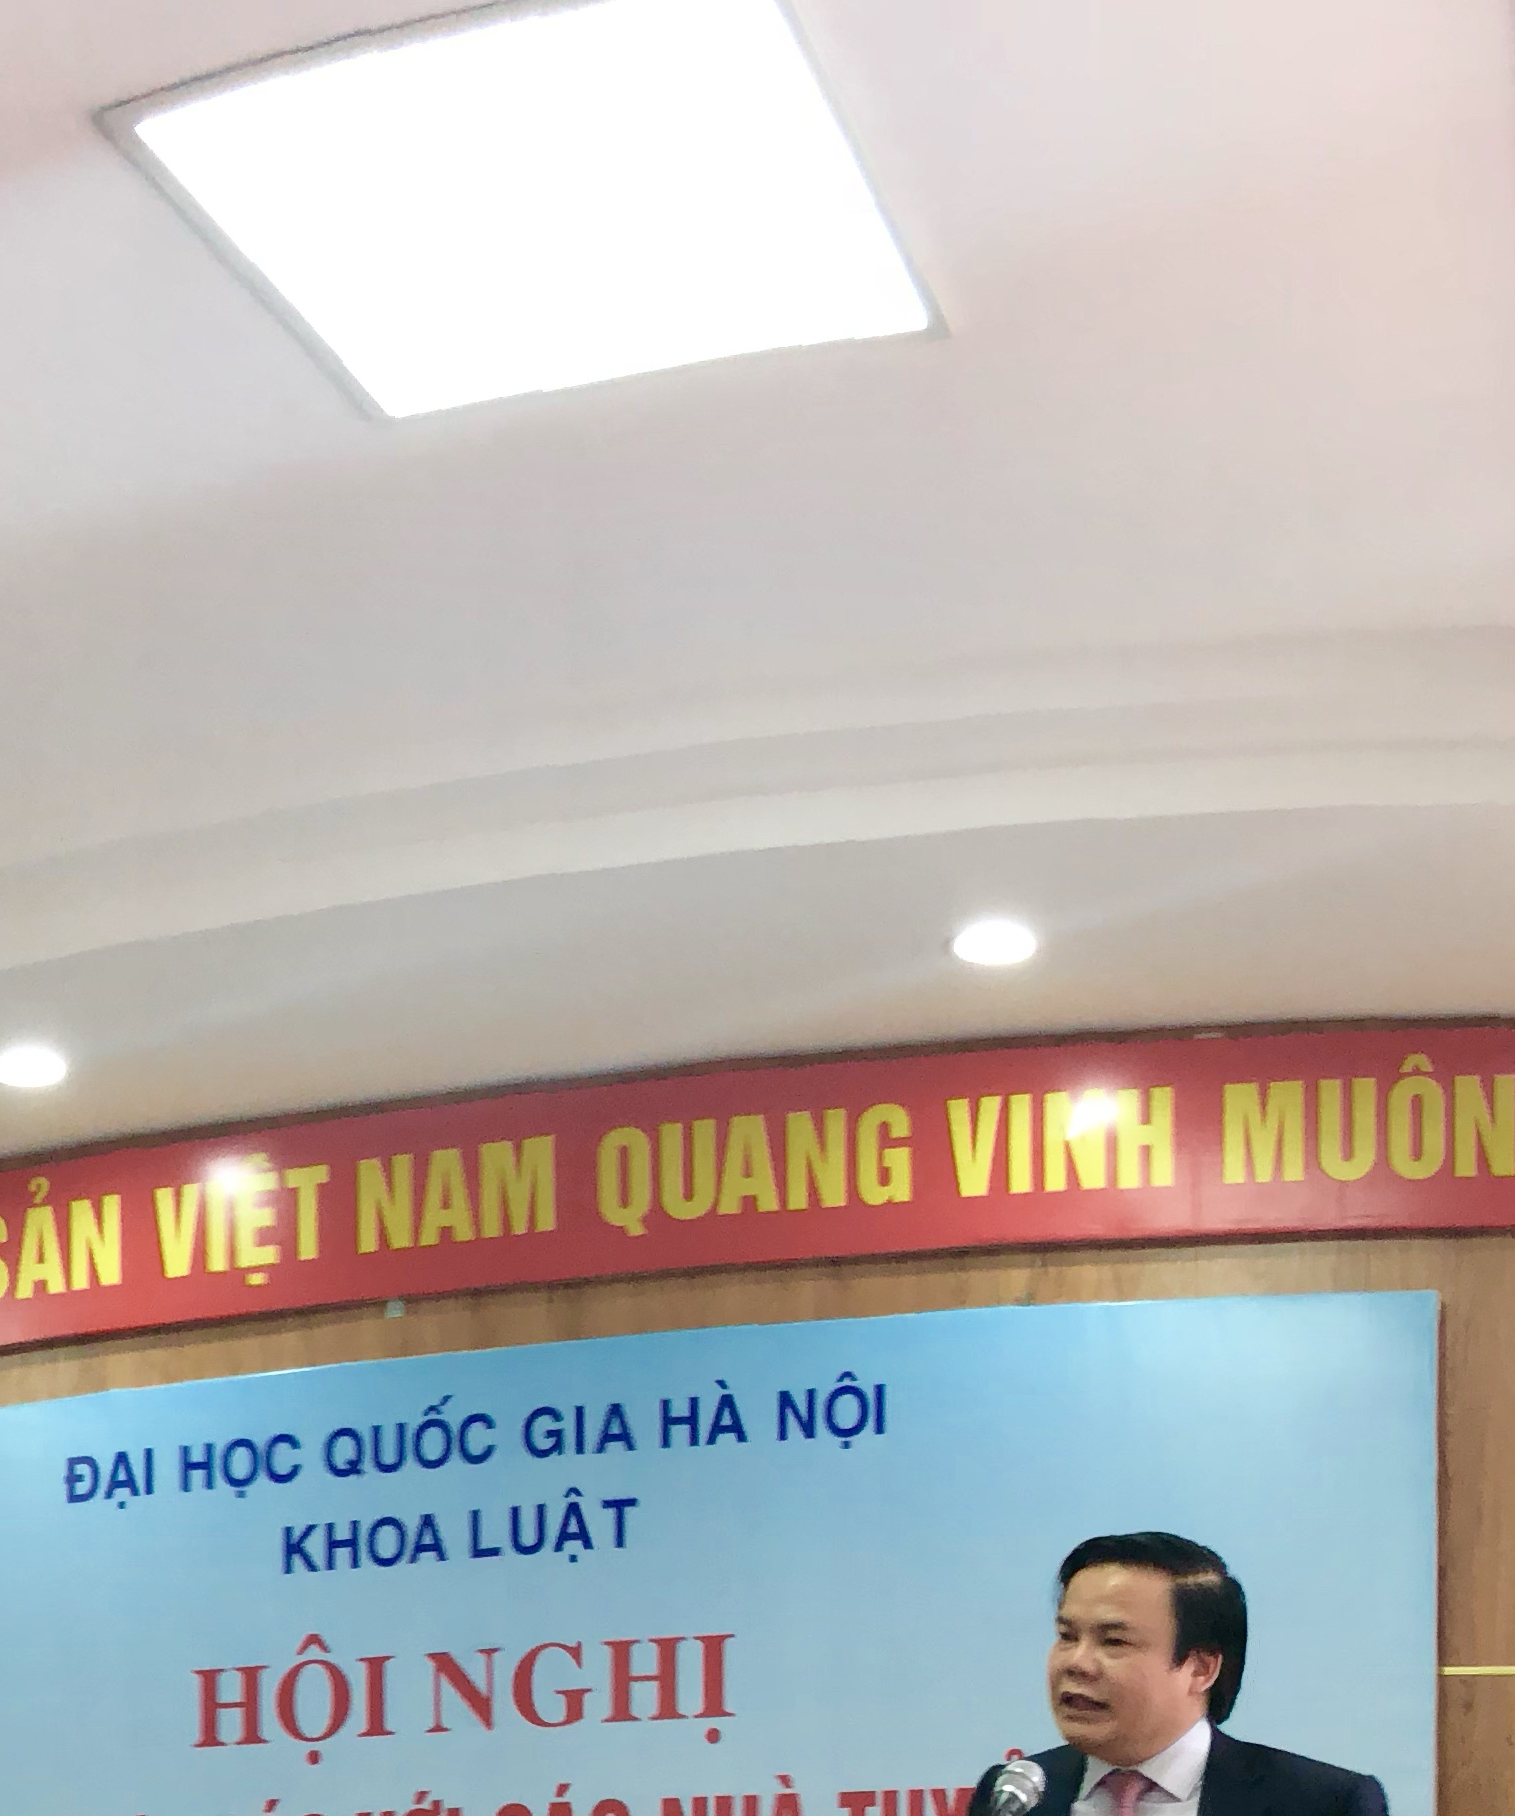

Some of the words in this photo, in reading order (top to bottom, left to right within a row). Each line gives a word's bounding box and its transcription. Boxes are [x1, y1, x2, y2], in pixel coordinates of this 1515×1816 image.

[152, 1155, 330, 1287] VIỆT
[356, 1134, 556, 1255] NAM
[596, 1102, 913, 1237] QUANG
[945, 1084, 1176, 1199] VINH
[64, 1446, 156, 1511] ĐẠI
[179, 1432, 303, 1499] HỌC
[322, 1393, 497, 1479] QUỐC
[520, 1402, 637, 1459] GIA
[658, 1378, 749, 1450] HÀ
[776, 1369, 888, 1451] NỘI
[281, 1514, 450, 1576] KHOA
[467, 1486, 640, 1565] LUẬT
[192, 1633, 400, 1766] HỘI
[426, 1632, 738, 1745] NGHỊ
